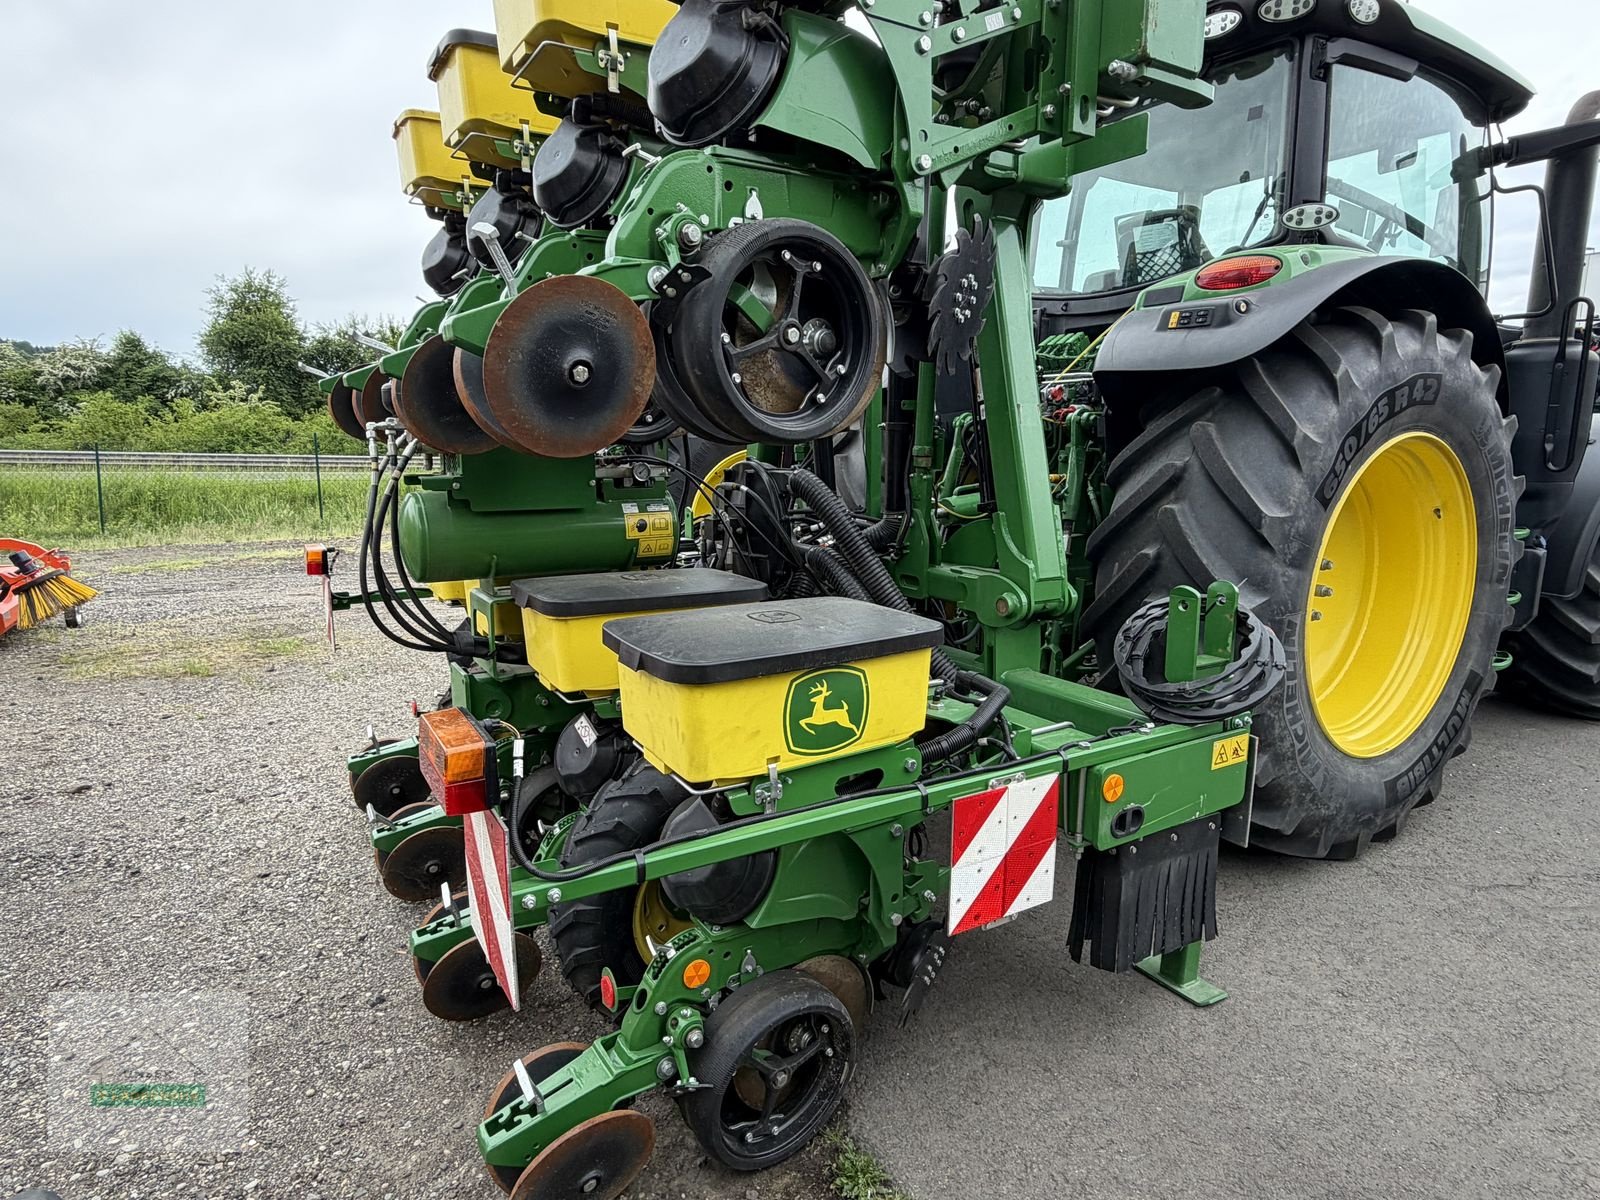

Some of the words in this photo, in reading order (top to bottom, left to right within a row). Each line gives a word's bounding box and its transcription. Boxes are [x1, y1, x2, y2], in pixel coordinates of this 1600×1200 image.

[1323, 396, 1390, 500] 650/65
[1394, 386, 1410, 413] R
[1412, 377, 1438, 402] 42
[1486, 441, 1512, 585] MICHELIN
[1284, 618, 1323, 778] MICHELIN
[1396, 688, 1472, 799] MULTIBIB
